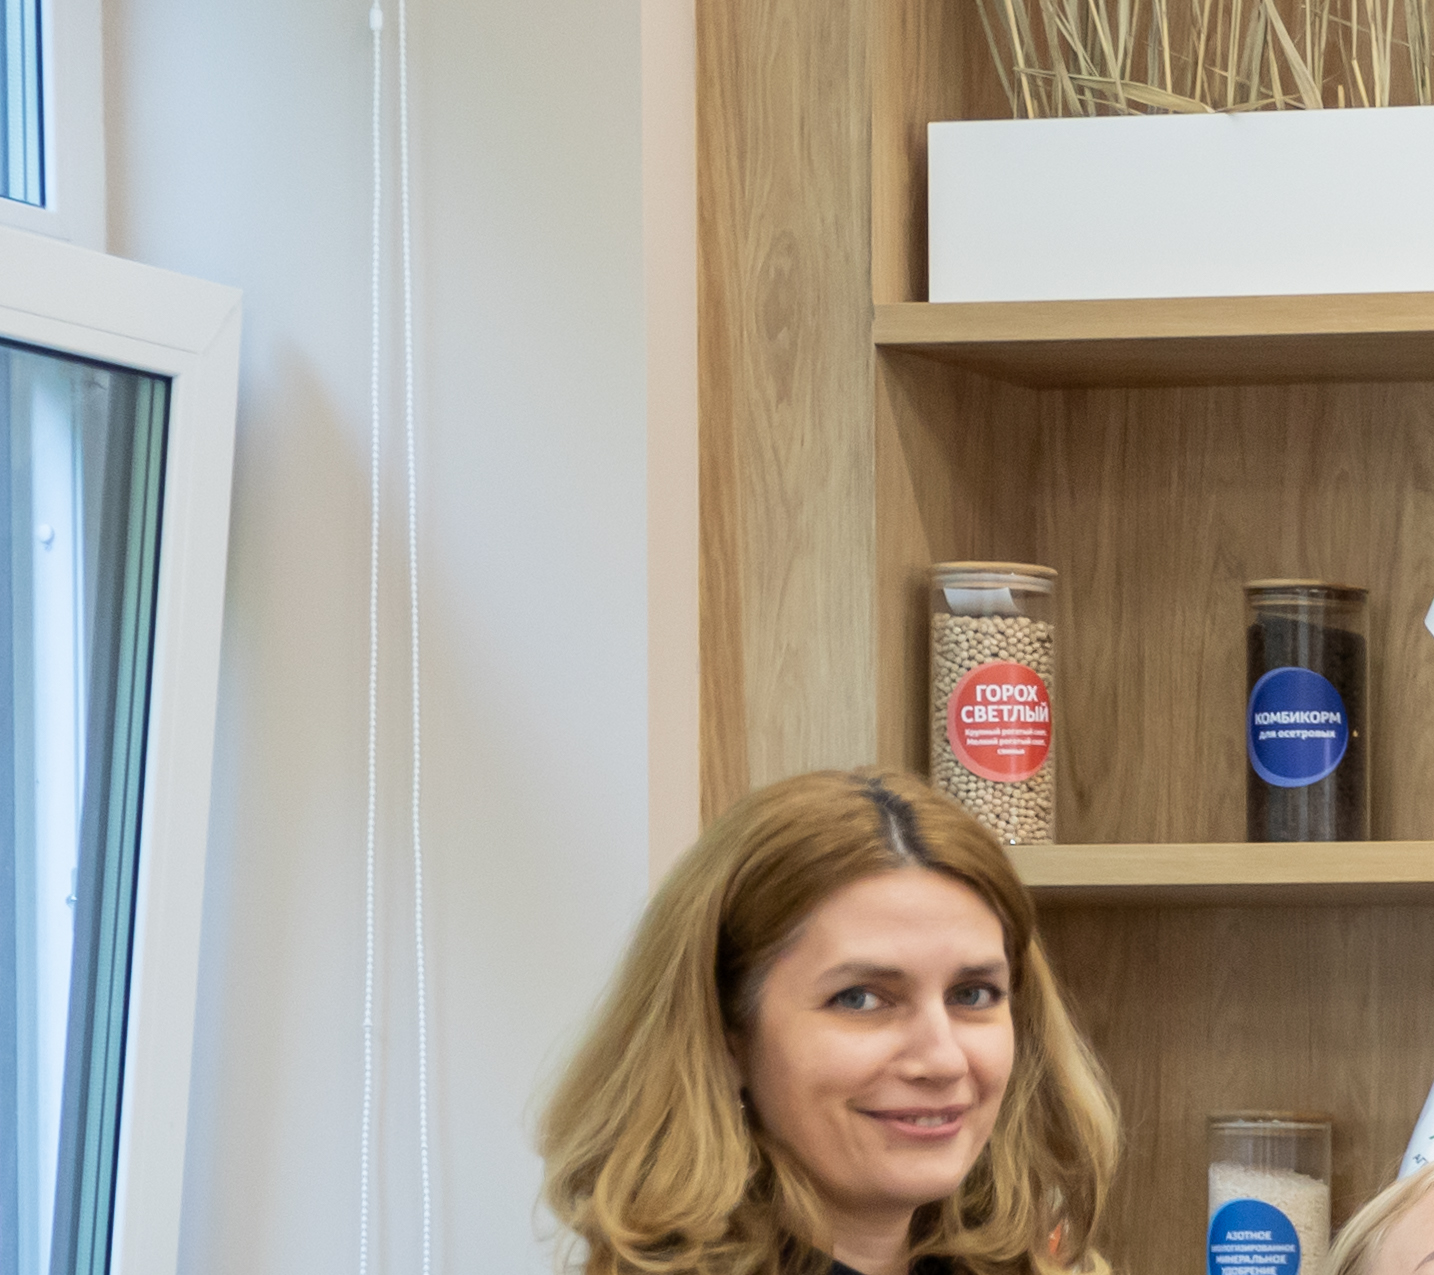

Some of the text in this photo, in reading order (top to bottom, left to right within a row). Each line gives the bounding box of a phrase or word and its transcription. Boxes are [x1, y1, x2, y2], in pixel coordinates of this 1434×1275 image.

[976, 684, 1039, 702] ГОРОХ
[961, 702, 1049, 723] СВЕТЛЫЙ
[1254, 711, 1342, 725] КОМБИКОРМ
